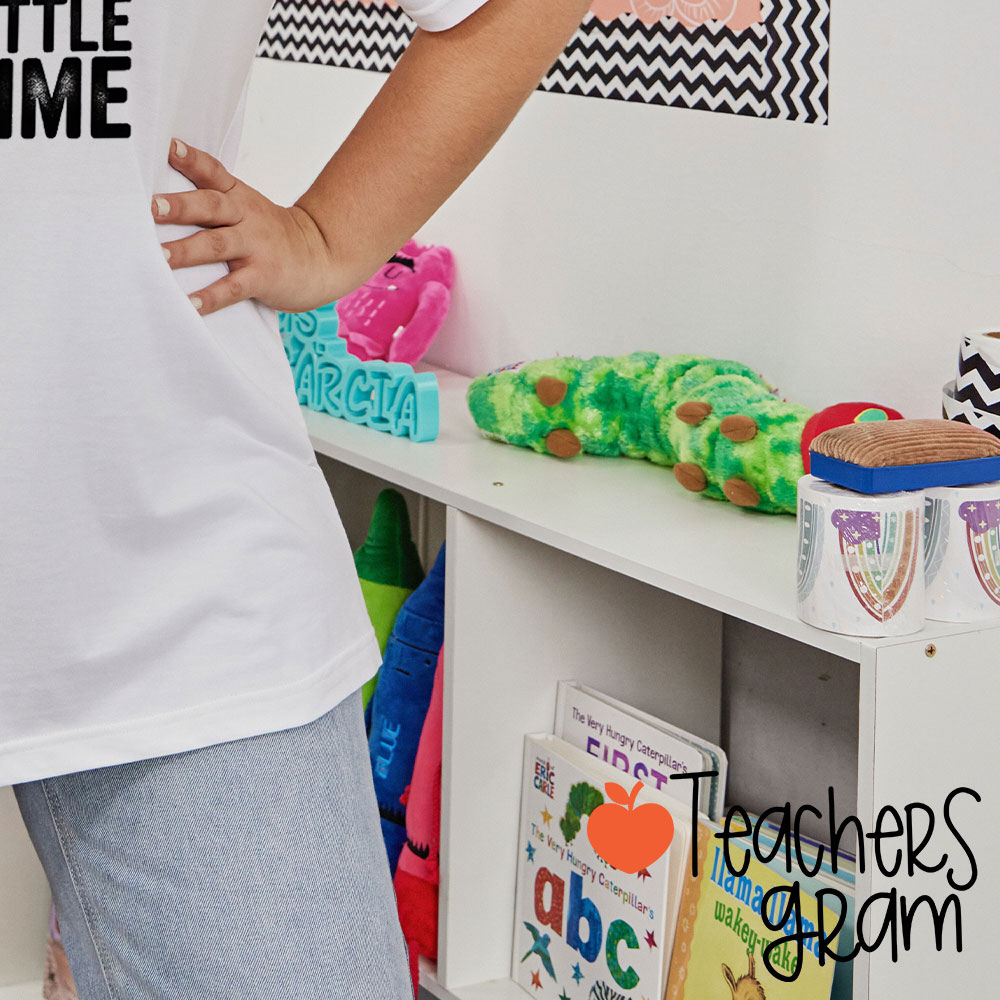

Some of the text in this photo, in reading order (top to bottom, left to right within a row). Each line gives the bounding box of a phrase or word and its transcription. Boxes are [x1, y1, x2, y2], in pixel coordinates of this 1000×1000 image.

[295, 352, 418, 437] ARCIA
[374, 716, 401, 779] BLUE
[534, 761, 555, 786] ERIC
[572, 706, 688, 774] The Very Hungry Caterpillar's
[533, 775, 555, 800] CARLE
[531, 823, 654, 920] The Very Hungry Caterpillar's
[534, 866, 640, 991] abc
